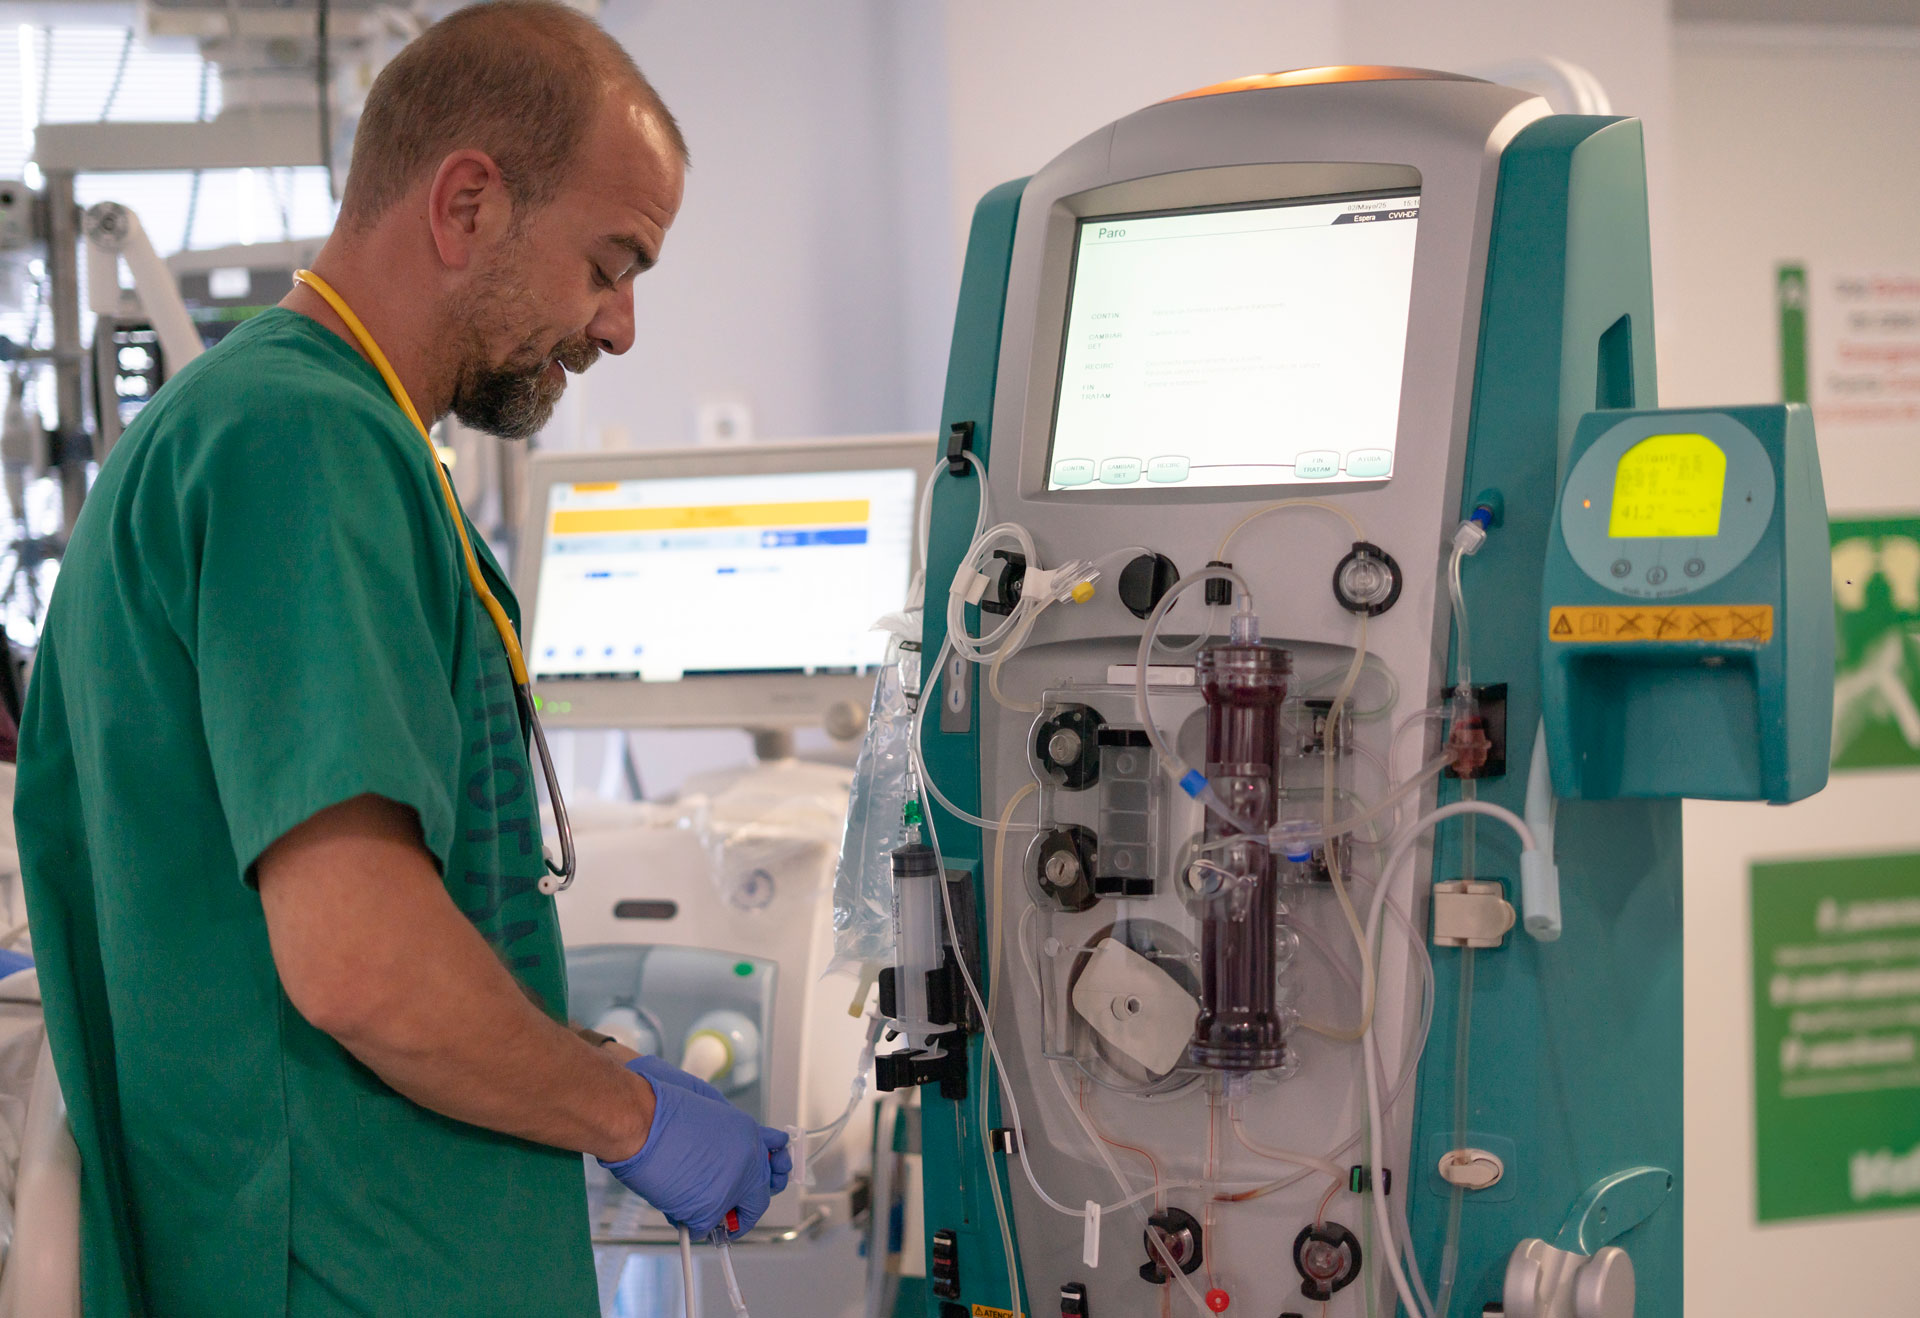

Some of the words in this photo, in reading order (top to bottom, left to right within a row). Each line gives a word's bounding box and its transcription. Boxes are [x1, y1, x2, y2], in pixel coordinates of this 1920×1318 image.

[1347, 202, 1387, 212] 02/Mayo/25
[1353, 214, 1376, 223] Espera
[1388, 210, 1418, 220] CVVHDF
[1098, 227, 1126, 239] Paro
[1090, 312, 1120, 320] CONTIN
[1088, 332, 1122, 341] CAMBIAR
